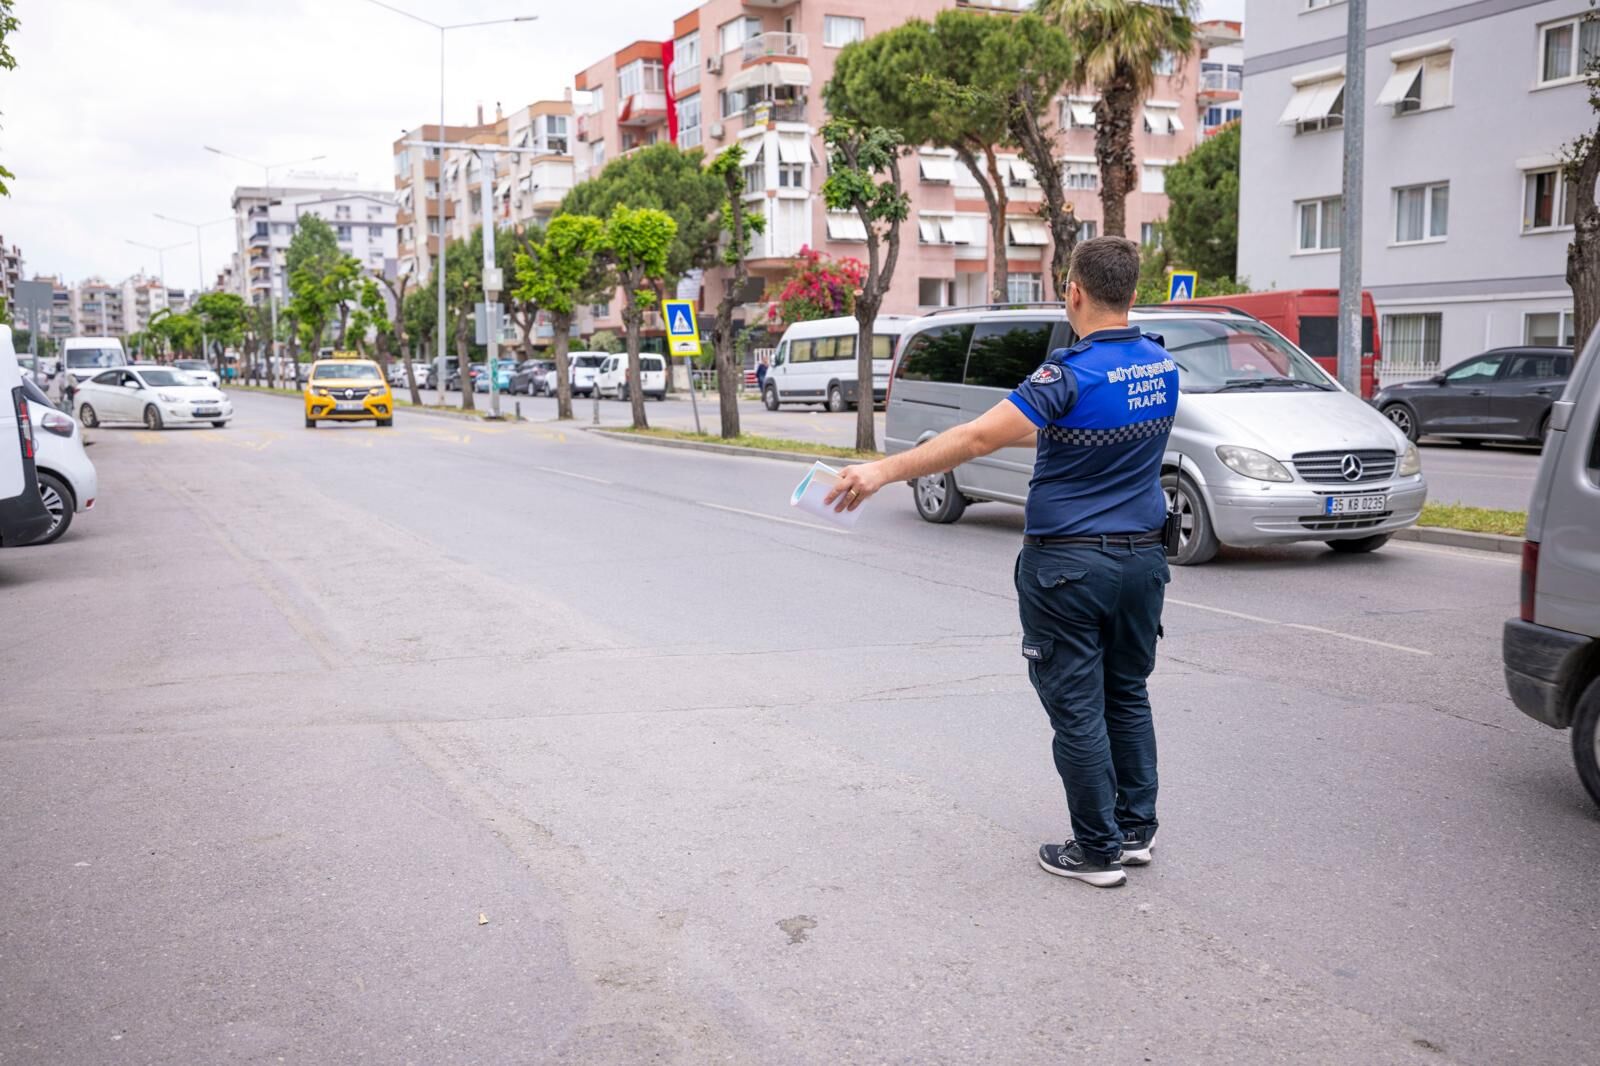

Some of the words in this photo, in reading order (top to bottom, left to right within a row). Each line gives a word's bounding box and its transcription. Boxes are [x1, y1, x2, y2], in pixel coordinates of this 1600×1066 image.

[1128, 377, 1166, 396] ZABITA
[1128, 391, 1167, 411] TRAFİK
[1333, 498, 1344, 511] 35
[1348, 498, 1360, 511] KB
[1362, 496, 1383, 510] 0235
